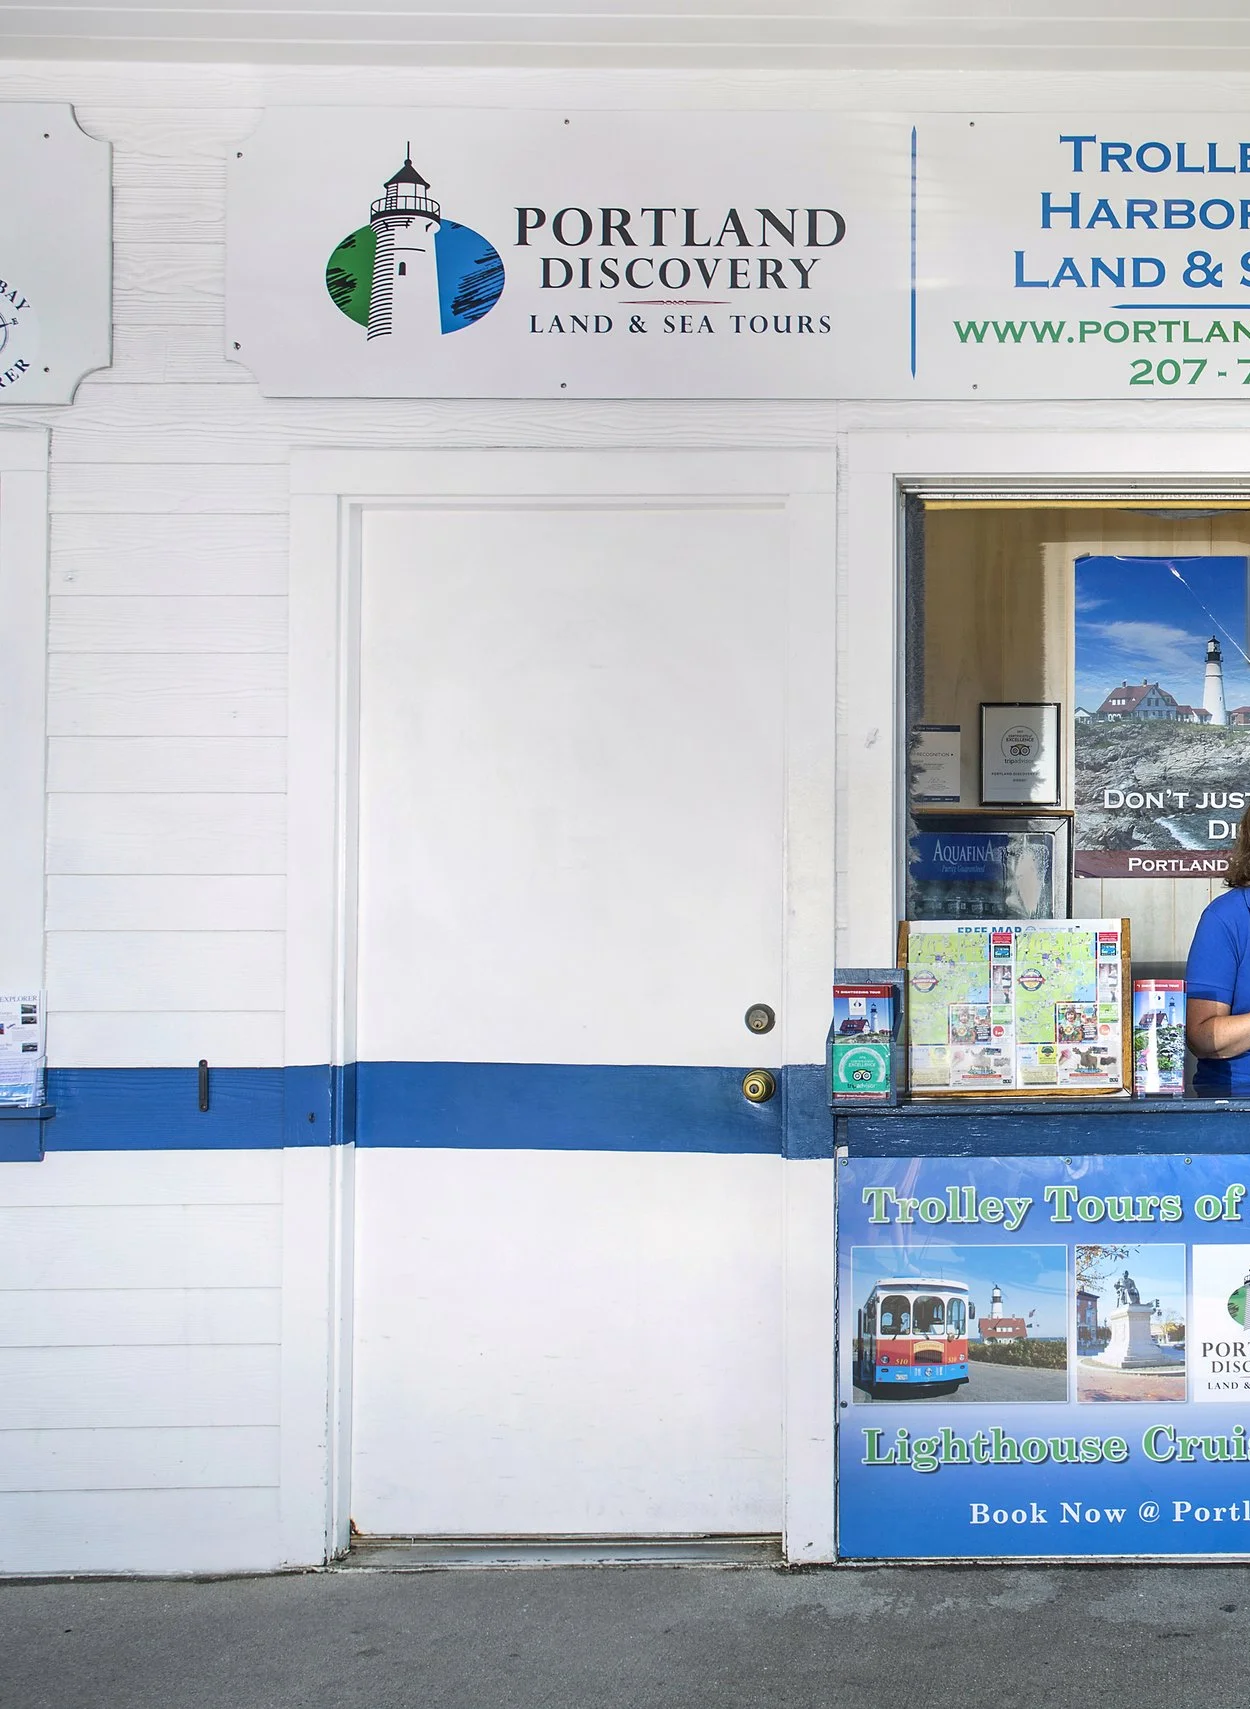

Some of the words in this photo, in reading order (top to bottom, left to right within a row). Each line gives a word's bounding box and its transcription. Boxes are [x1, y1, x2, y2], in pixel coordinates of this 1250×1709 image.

[514, 208, 845, 247] PORTLAND
[540, 258, 820, 289] DISCOVERY
[1014, 251, 1165, 289] LAND
[1183, 251, 1222, 288] &
[531, 315, 612, 333] LAND
[629, 315, 647, 333] &
[664, 315, 714, 333] SEA
[730, 315, 830, 333] TOURS
[1104, 789, 1190, 809] DON'T
[933, 839, 995, 865] AQUAFINA
[1128, 857, 1235, 872] PORTLAND'
[862, 1186, 1032, 1231] Trolley
[1044, 1186, 1182, 1223] Tours
[1194, 1184, 1246, 1222] of
[862, 1428, 1128, 1472] Lighthouse
[970, 1503, 1047, 1524] Book
[1060, 1503, 1126, 1523] Now
[1139, 1501, 1159, 1522] @
